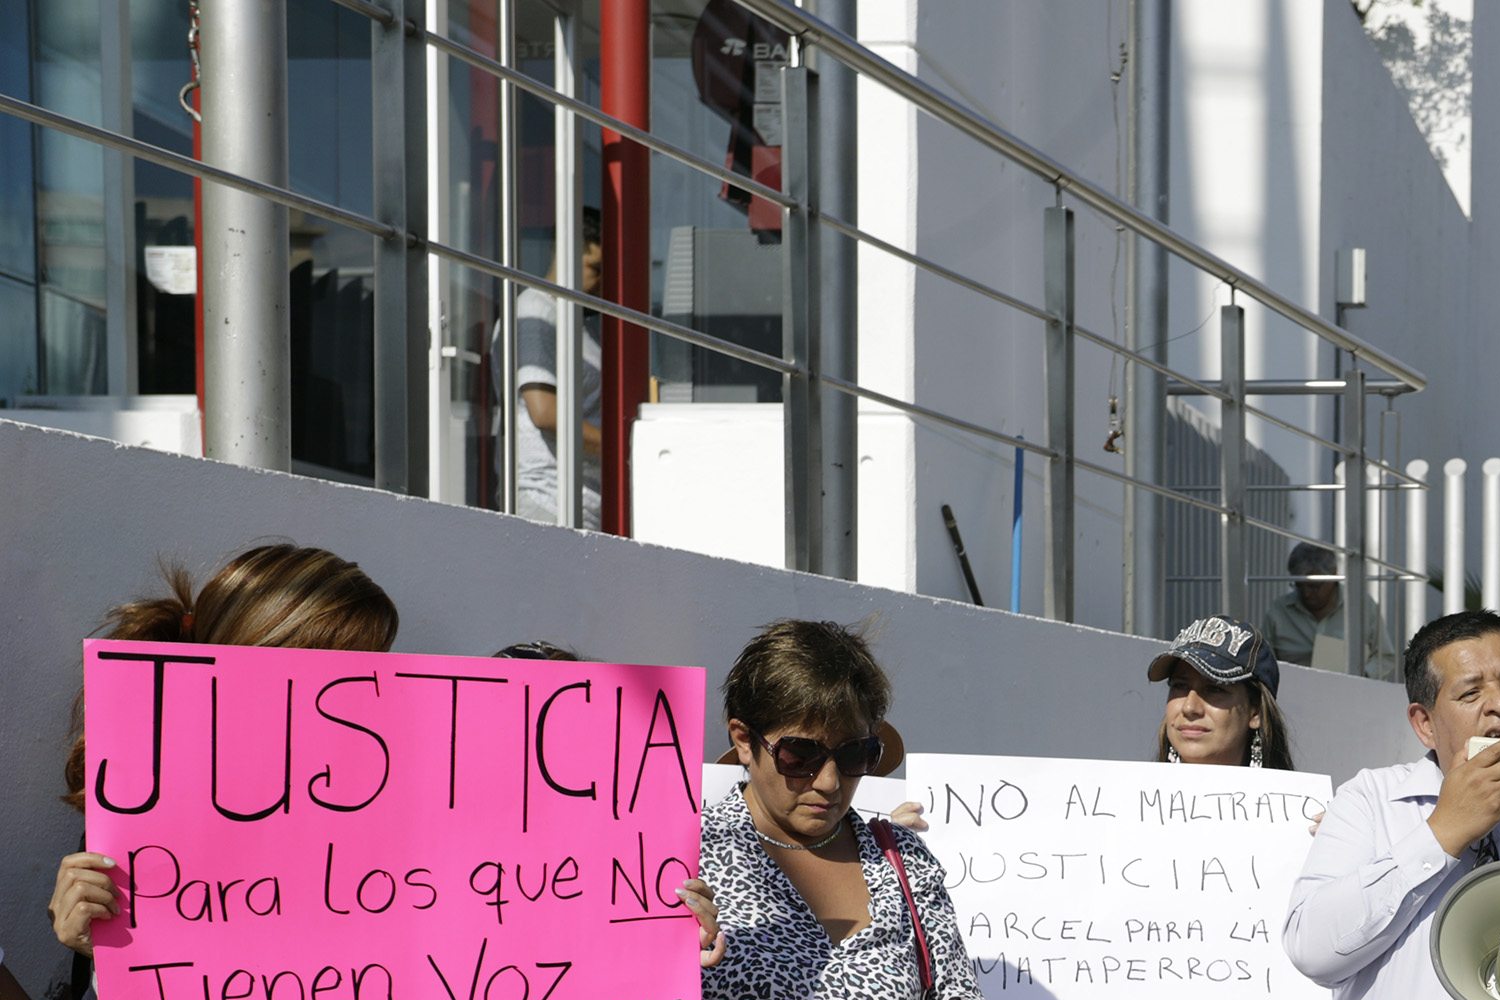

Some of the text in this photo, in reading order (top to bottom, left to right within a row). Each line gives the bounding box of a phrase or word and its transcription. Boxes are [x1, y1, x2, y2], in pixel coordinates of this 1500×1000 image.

[94, 650, 698, 834] JUSTICIA
[1064, 784, 1116, 820] AL
[1140, 788, 1326, 826] MALTRATO
[126, 845, 281, 929] Para
[469, 855, 584, 925] que
[610, 832, 692, 916] NO
[968, 911, 1269, 944] ARCEL PARA LA
